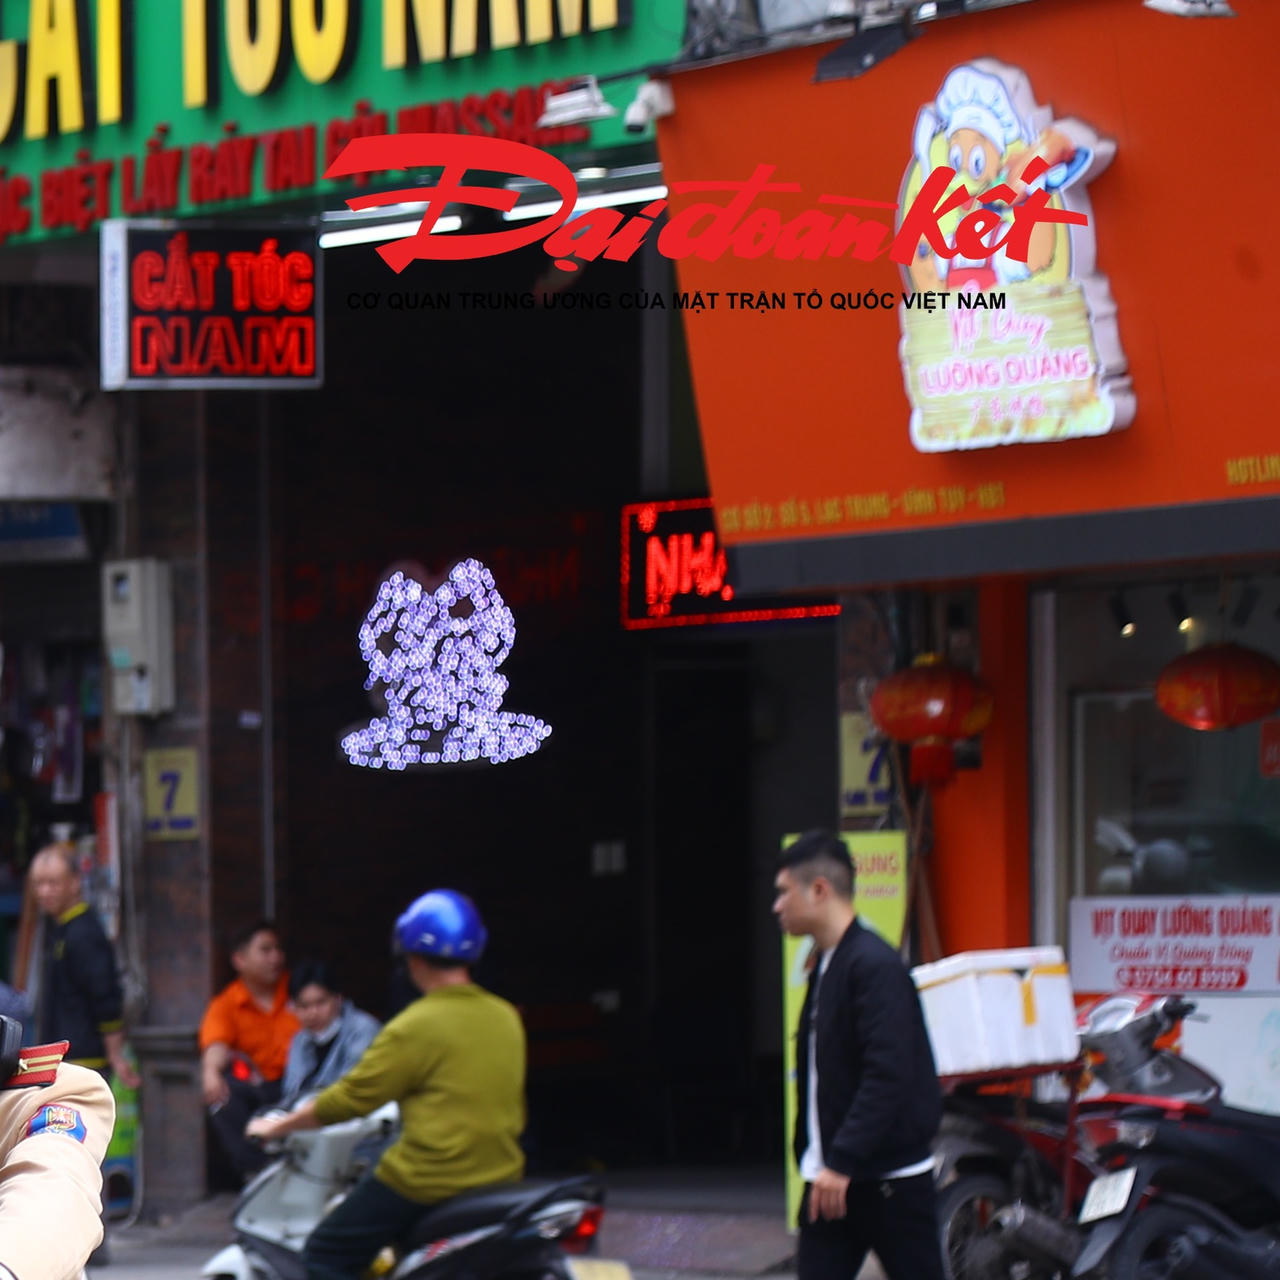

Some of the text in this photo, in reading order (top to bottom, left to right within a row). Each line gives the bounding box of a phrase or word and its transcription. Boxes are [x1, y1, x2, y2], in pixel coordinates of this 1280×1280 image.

[227, 237, 315, 312] TÓC
[131, 316, 315, 376] NAM
[159, 770, 182, 812] 7
